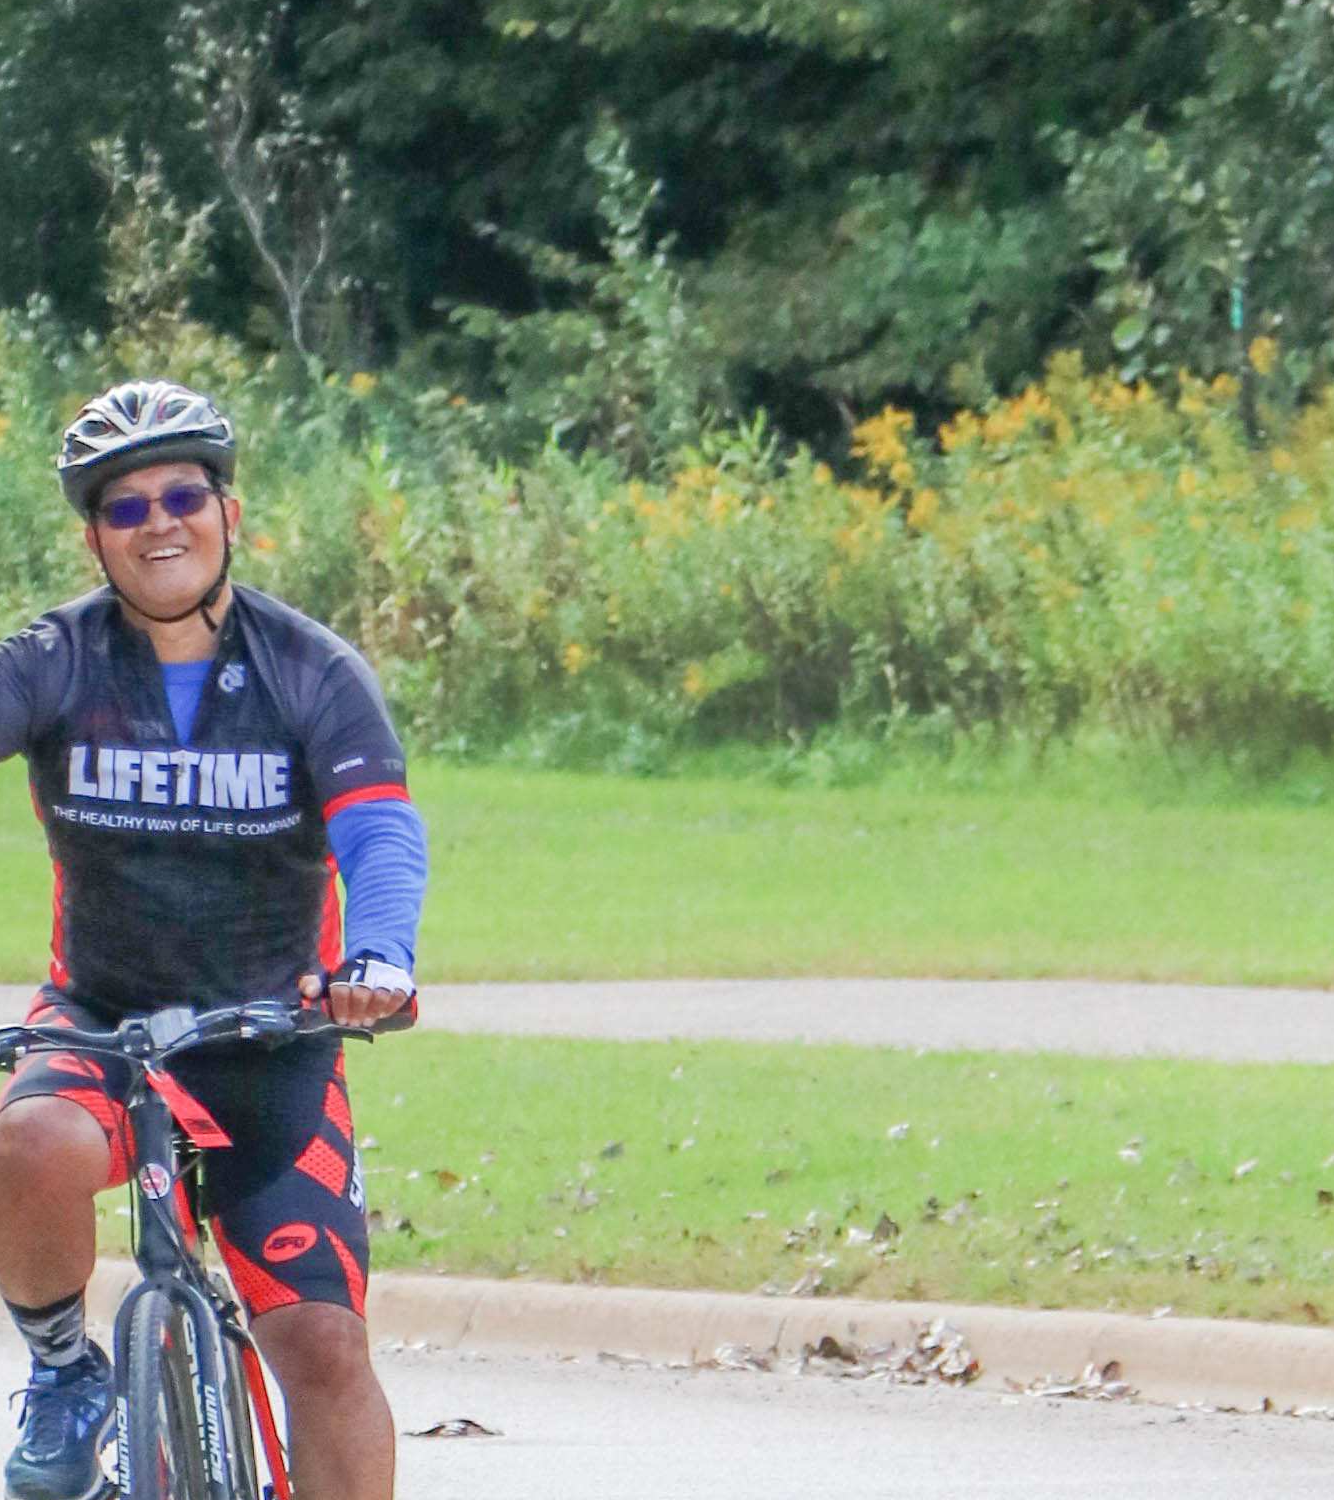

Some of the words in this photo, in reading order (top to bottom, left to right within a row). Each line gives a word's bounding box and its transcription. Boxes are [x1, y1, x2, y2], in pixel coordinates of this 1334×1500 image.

[69, 746, 289, 810] LIFETIME
[53, 804, 76, 822] THE
[79, 810, 144, 830] HEALTHY
[147, 818, 177, 831] WAY
[181, 818, 201, 832] OF
[204, 821, 234, 835] LIFE
[237, 811, 303, 836] COMPANY
